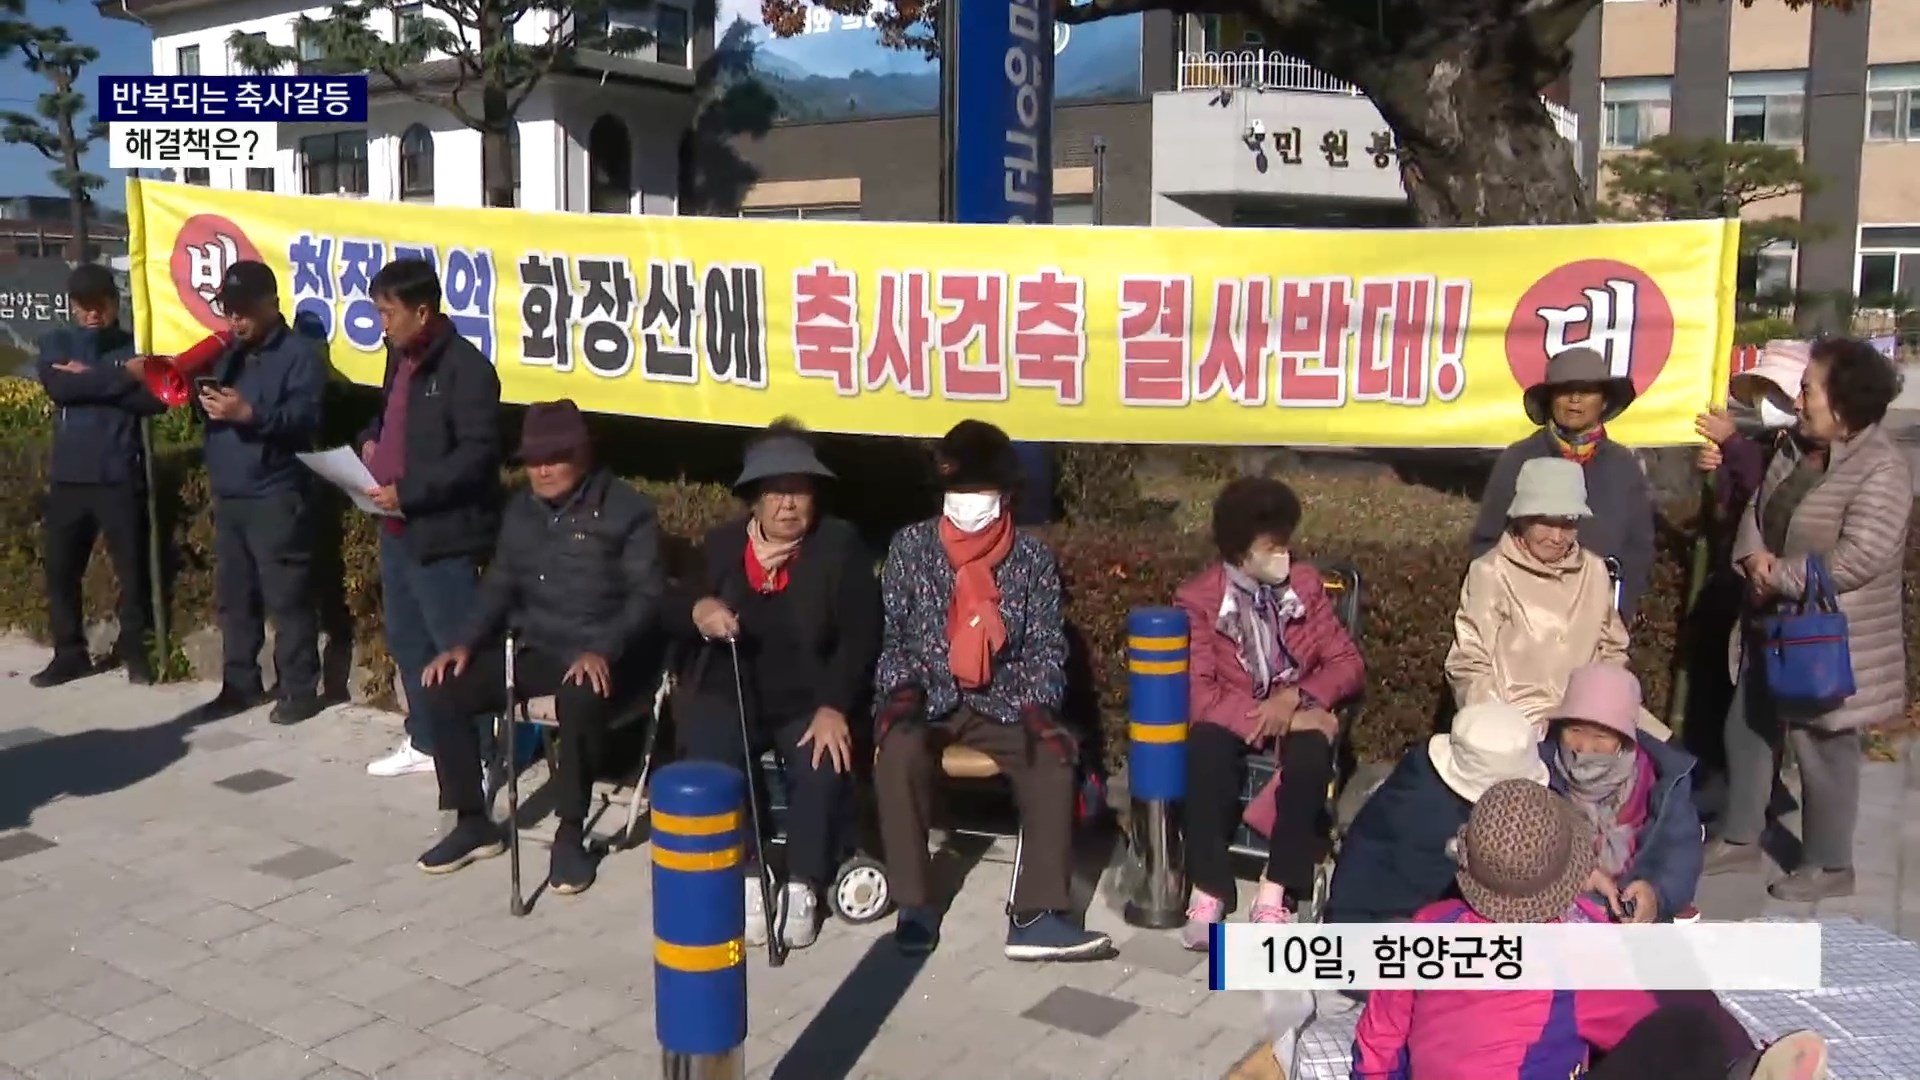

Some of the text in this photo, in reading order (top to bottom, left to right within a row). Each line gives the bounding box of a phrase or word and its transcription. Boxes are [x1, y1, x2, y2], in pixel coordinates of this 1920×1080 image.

[287, 233, 1472, 408] 청정역 화장산에 축사건축 결사반대!
